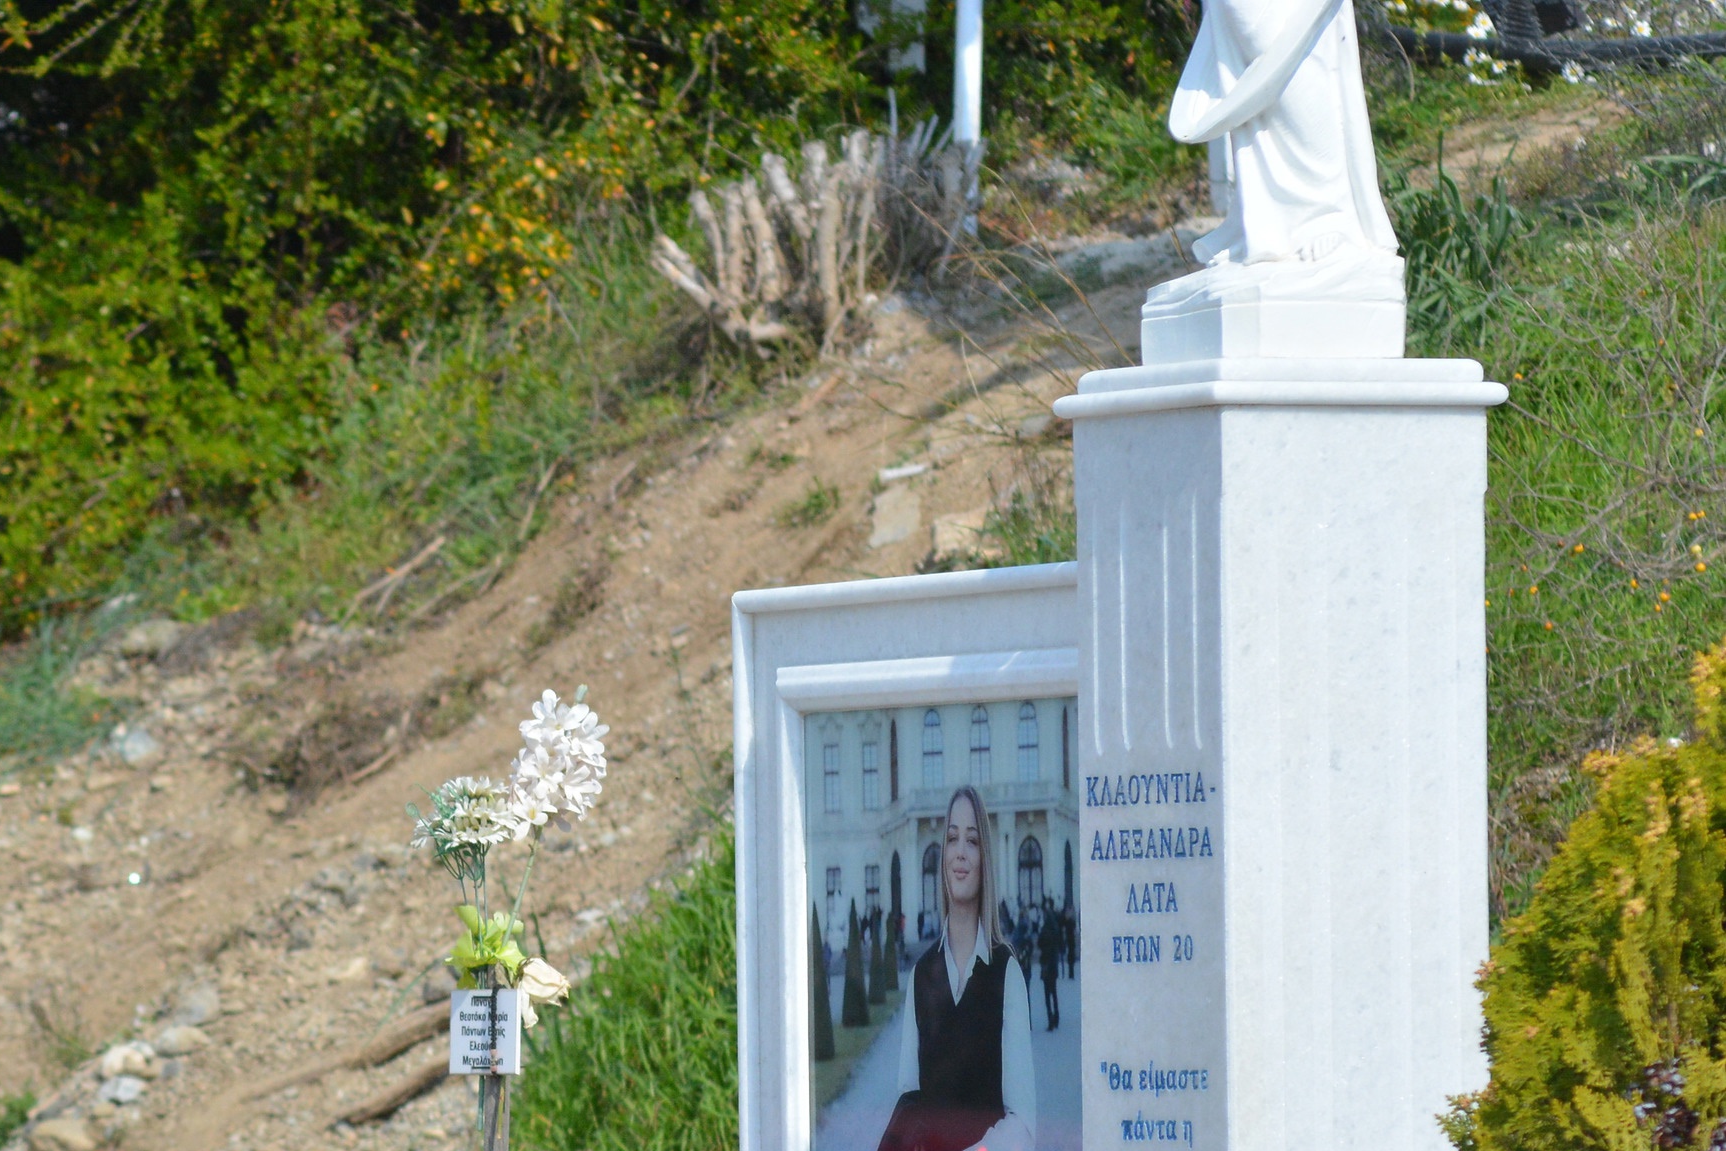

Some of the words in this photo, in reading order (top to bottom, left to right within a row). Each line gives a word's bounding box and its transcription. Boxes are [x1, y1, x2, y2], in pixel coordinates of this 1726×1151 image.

[1086, 772, 1216, 806] ΚΛΑΟΥΝΤΙΑ-
[1090, 826, 1213, 860] ΑΛΕΞΑΝΔΡΑ
[1126, 882, 1178, 913] ΛΑΤΑ
[1112, 935, 1160, 963] ΕΤΩΝ
[1173, 935, 1193, 961] 20
[461, 1026, 487, 1036] Πάντων
[488, 1026, 506, 1038] Επίς
[488, 1011, 508, 1024] Μρία
[1139, 1060, 1209, 1098] είμαστε
[1121, 1110, 1177, 1141] πάντα
[1183, 1120, 1193, 1149] η
